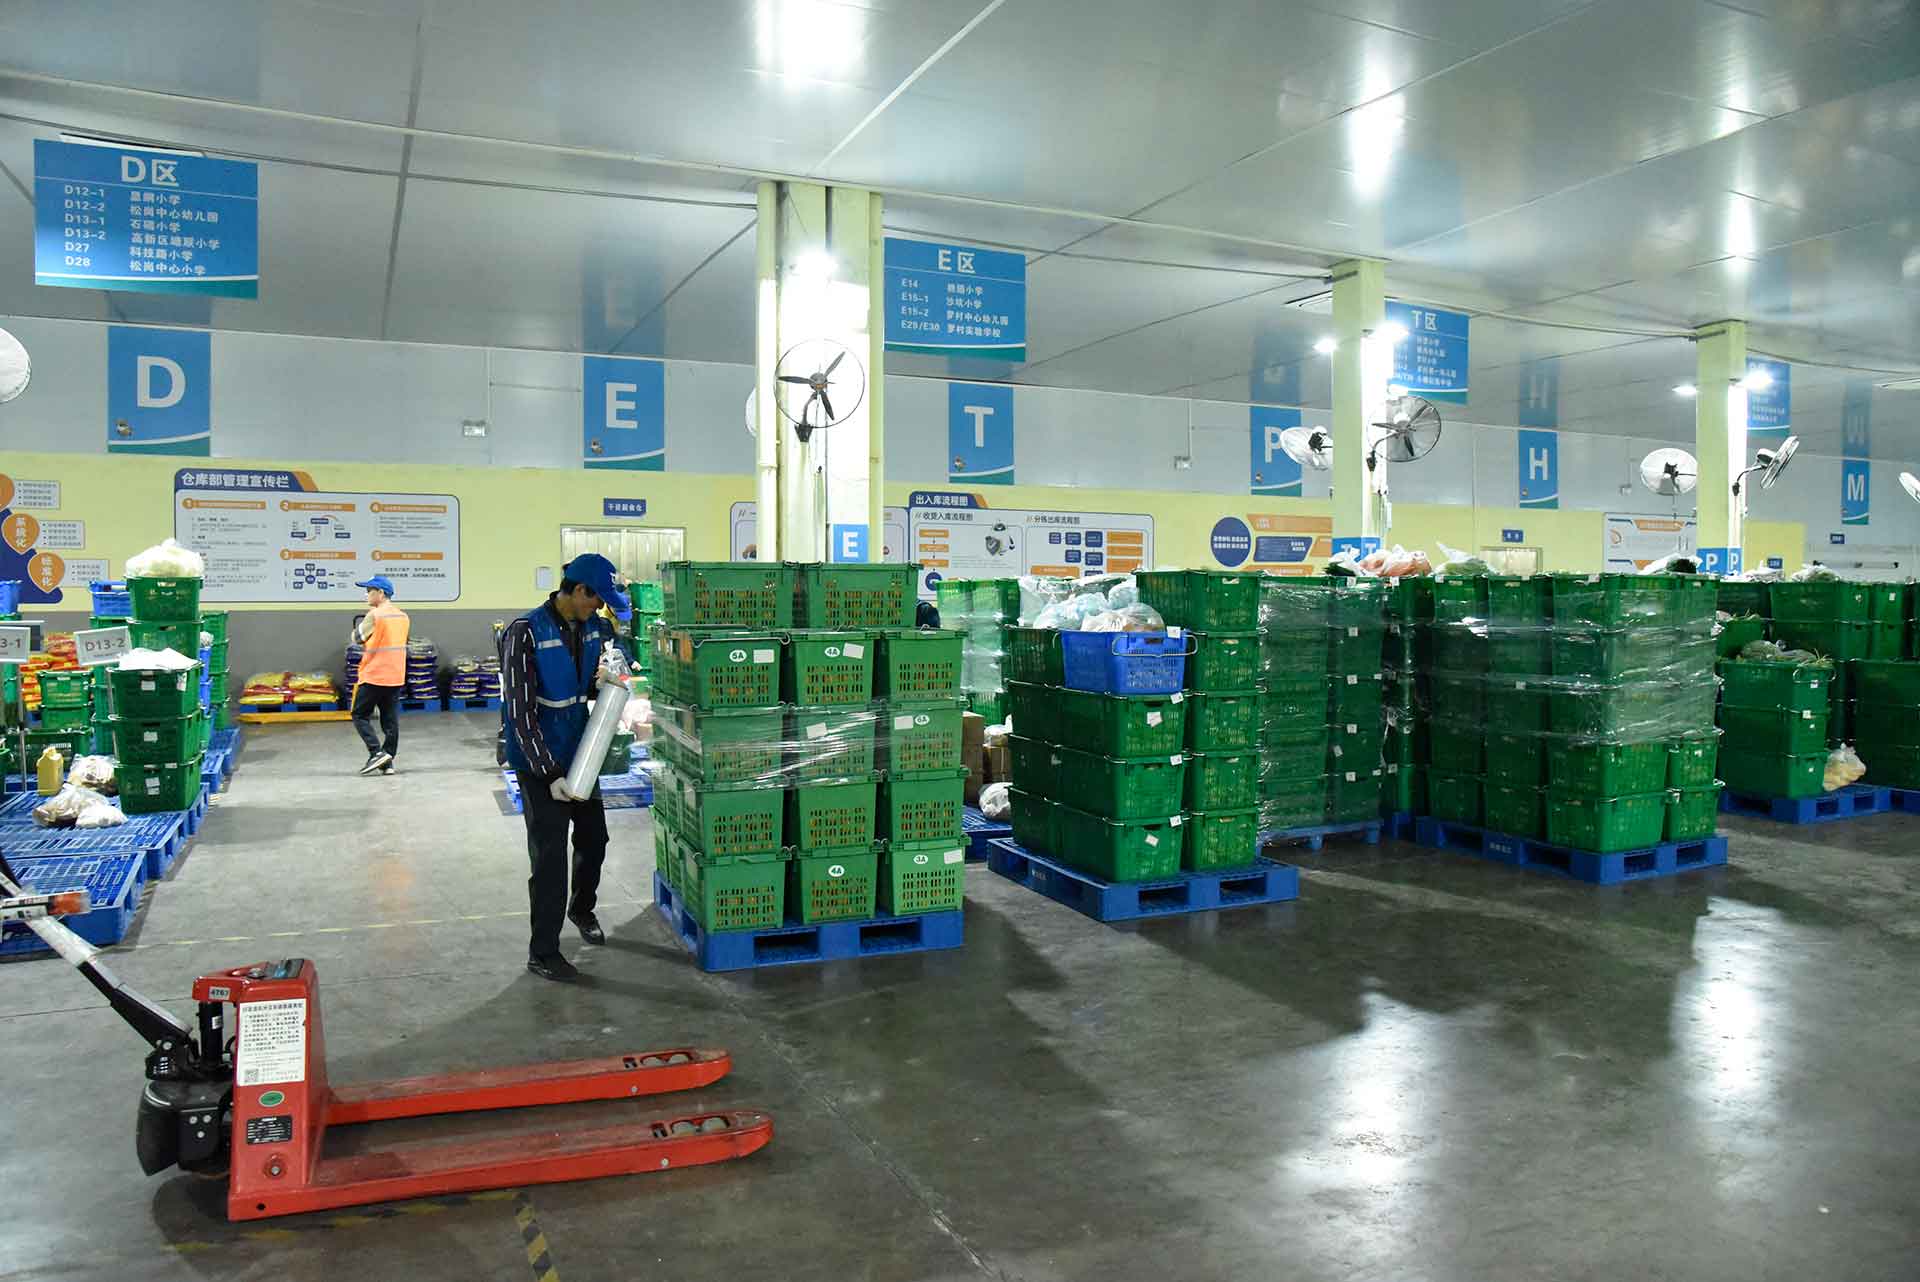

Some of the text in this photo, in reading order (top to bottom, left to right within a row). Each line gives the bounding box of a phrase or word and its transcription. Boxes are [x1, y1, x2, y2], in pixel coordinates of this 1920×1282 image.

[121, 155, 179, 187] D区
[64, 184, 104, 197] D12-1
[64, 199, 105, 212] D12-2
[64, 213, 105, 226] D13-1
[64, 228, 106, 240] D13-2
[64, 242, 89, 254] D27
[65, 256, 91, 268] D28
[938, 249, 976, 274] E区
[1411, 311, 1437, 331] T区
[137, 355, 186, 408] D
[605, 382, 638, 429] E
[964, 406, 994, 448] T
[1529, 447, 1548, 481] H
[181, 472, 290, 488] 仓库部管理宣传栏
[1847, 473, 1865, 501] M
[915, 495, 969, 507] 出入库流程图
[842, 531, 859, 558] E
[1706, 552, 1739, 572] P P
[85, 638, 125, 651] D13-2
